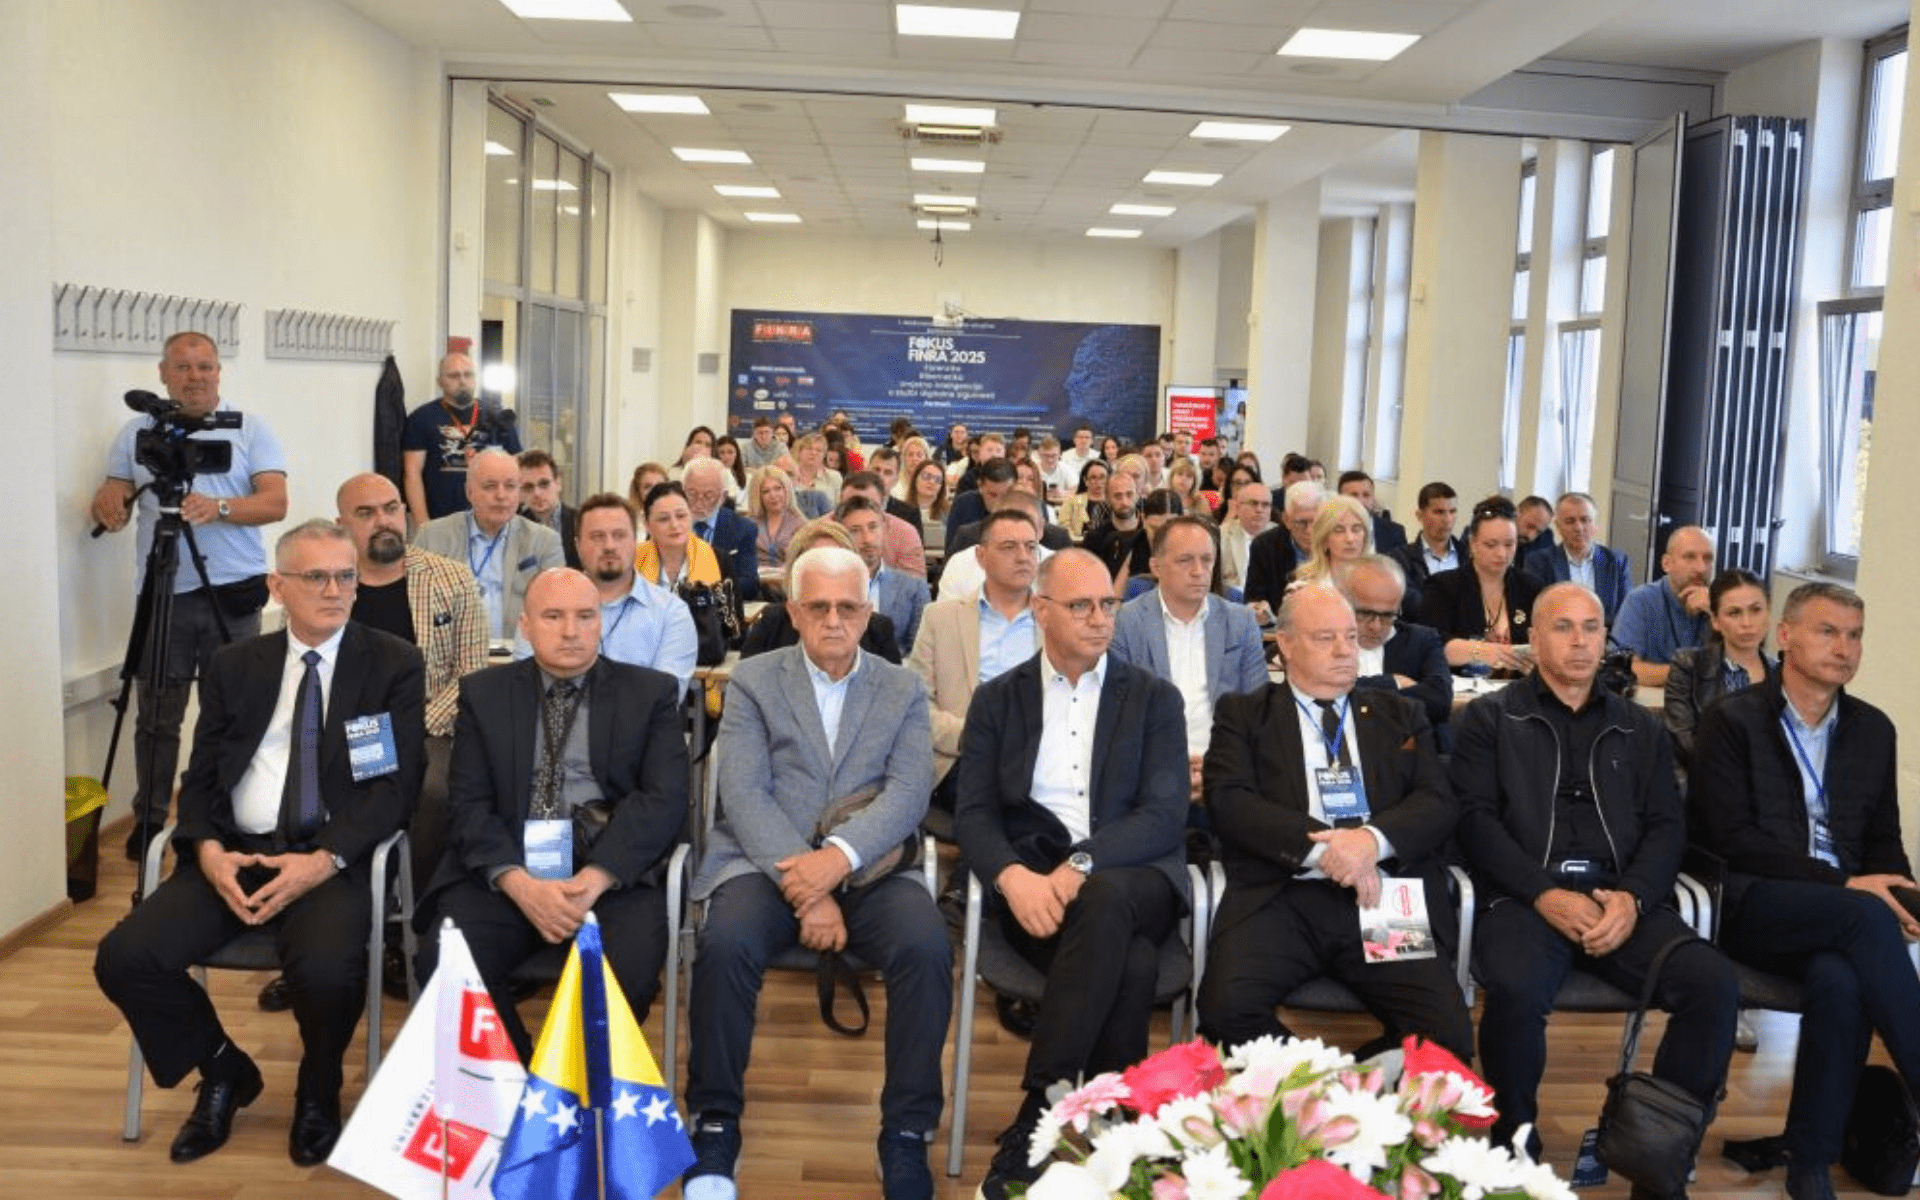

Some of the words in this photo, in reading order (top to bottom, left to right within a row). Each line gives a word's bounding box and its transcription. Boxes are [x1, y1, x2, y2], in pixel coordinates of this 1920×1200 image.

[908, 336, 954, 350] FOKUS
[908, 350, 948, 362] FINRA
[950, 351, 986, 364] 2025
